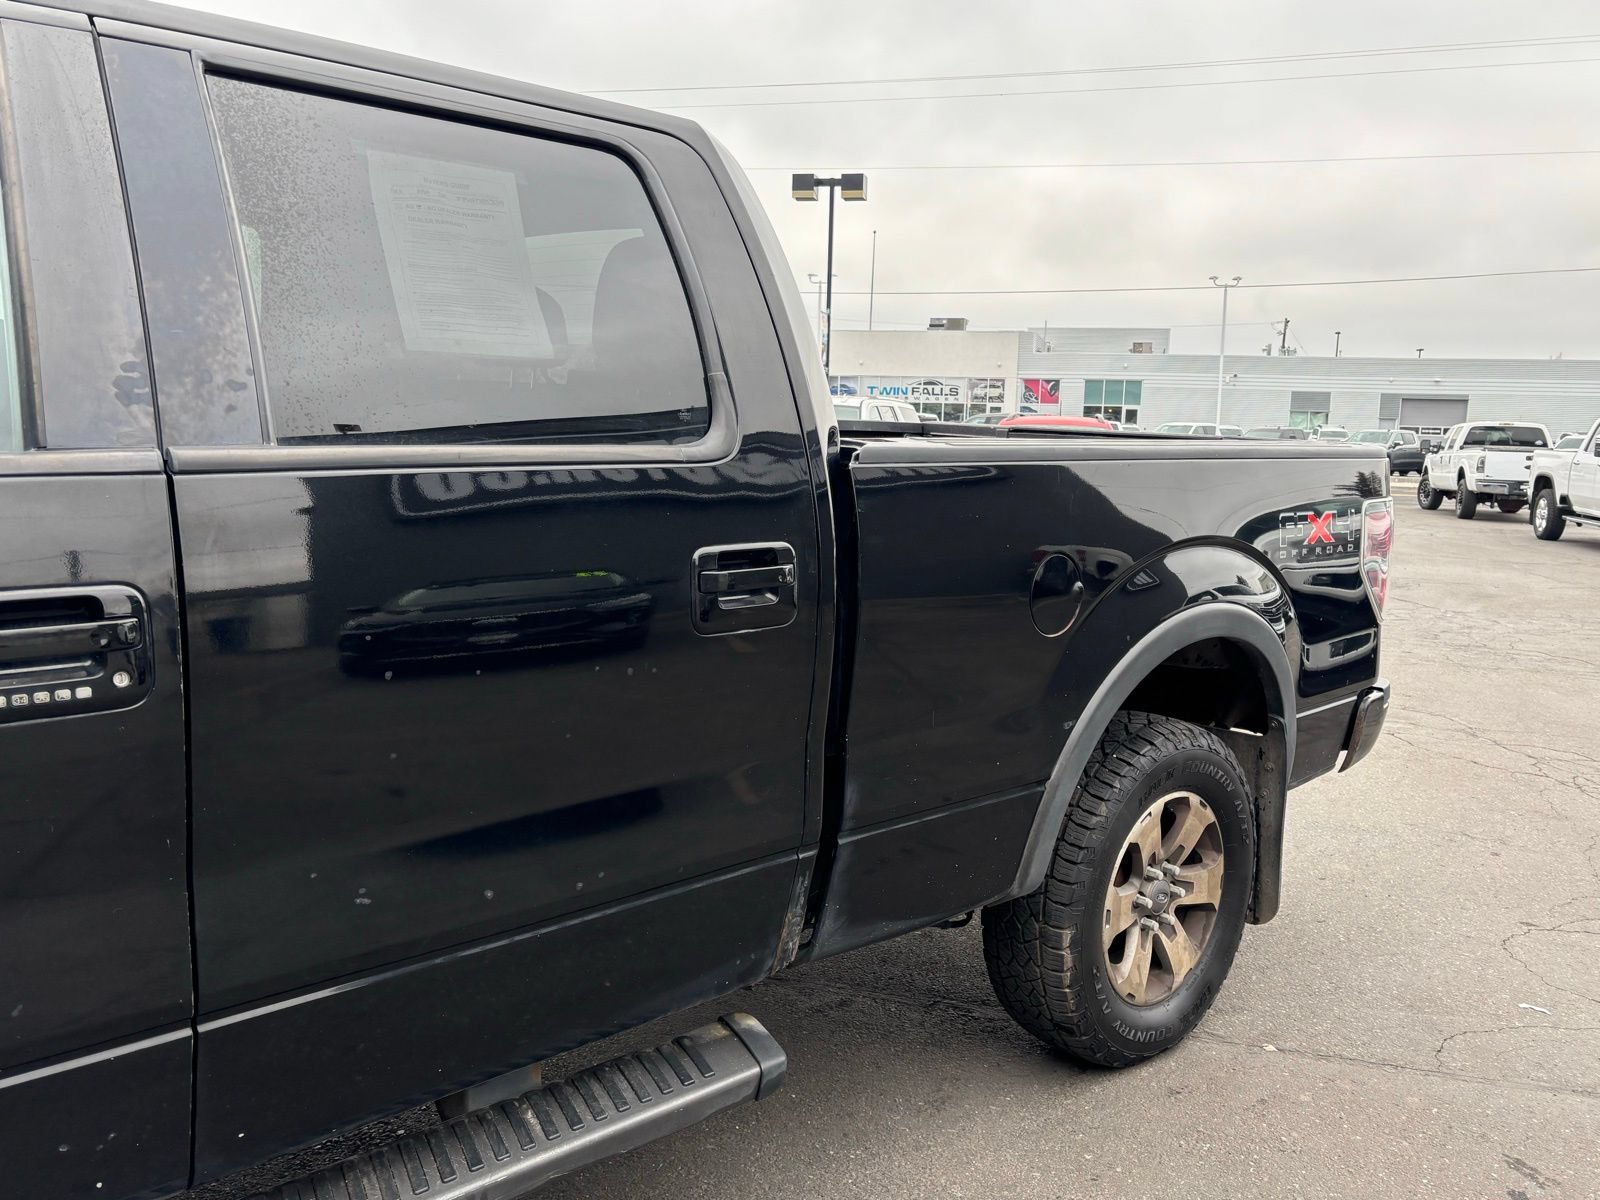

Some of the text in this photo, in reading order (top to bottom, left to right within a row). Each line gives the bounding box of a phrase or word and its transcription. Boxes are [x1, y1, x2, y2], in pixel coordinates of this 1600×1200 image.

[867, 386, 959, 396] TWIN FALLS
[1279, 509, 1355, 547] FX4
[1279, 543, 1354, 559] OFF ROAD
